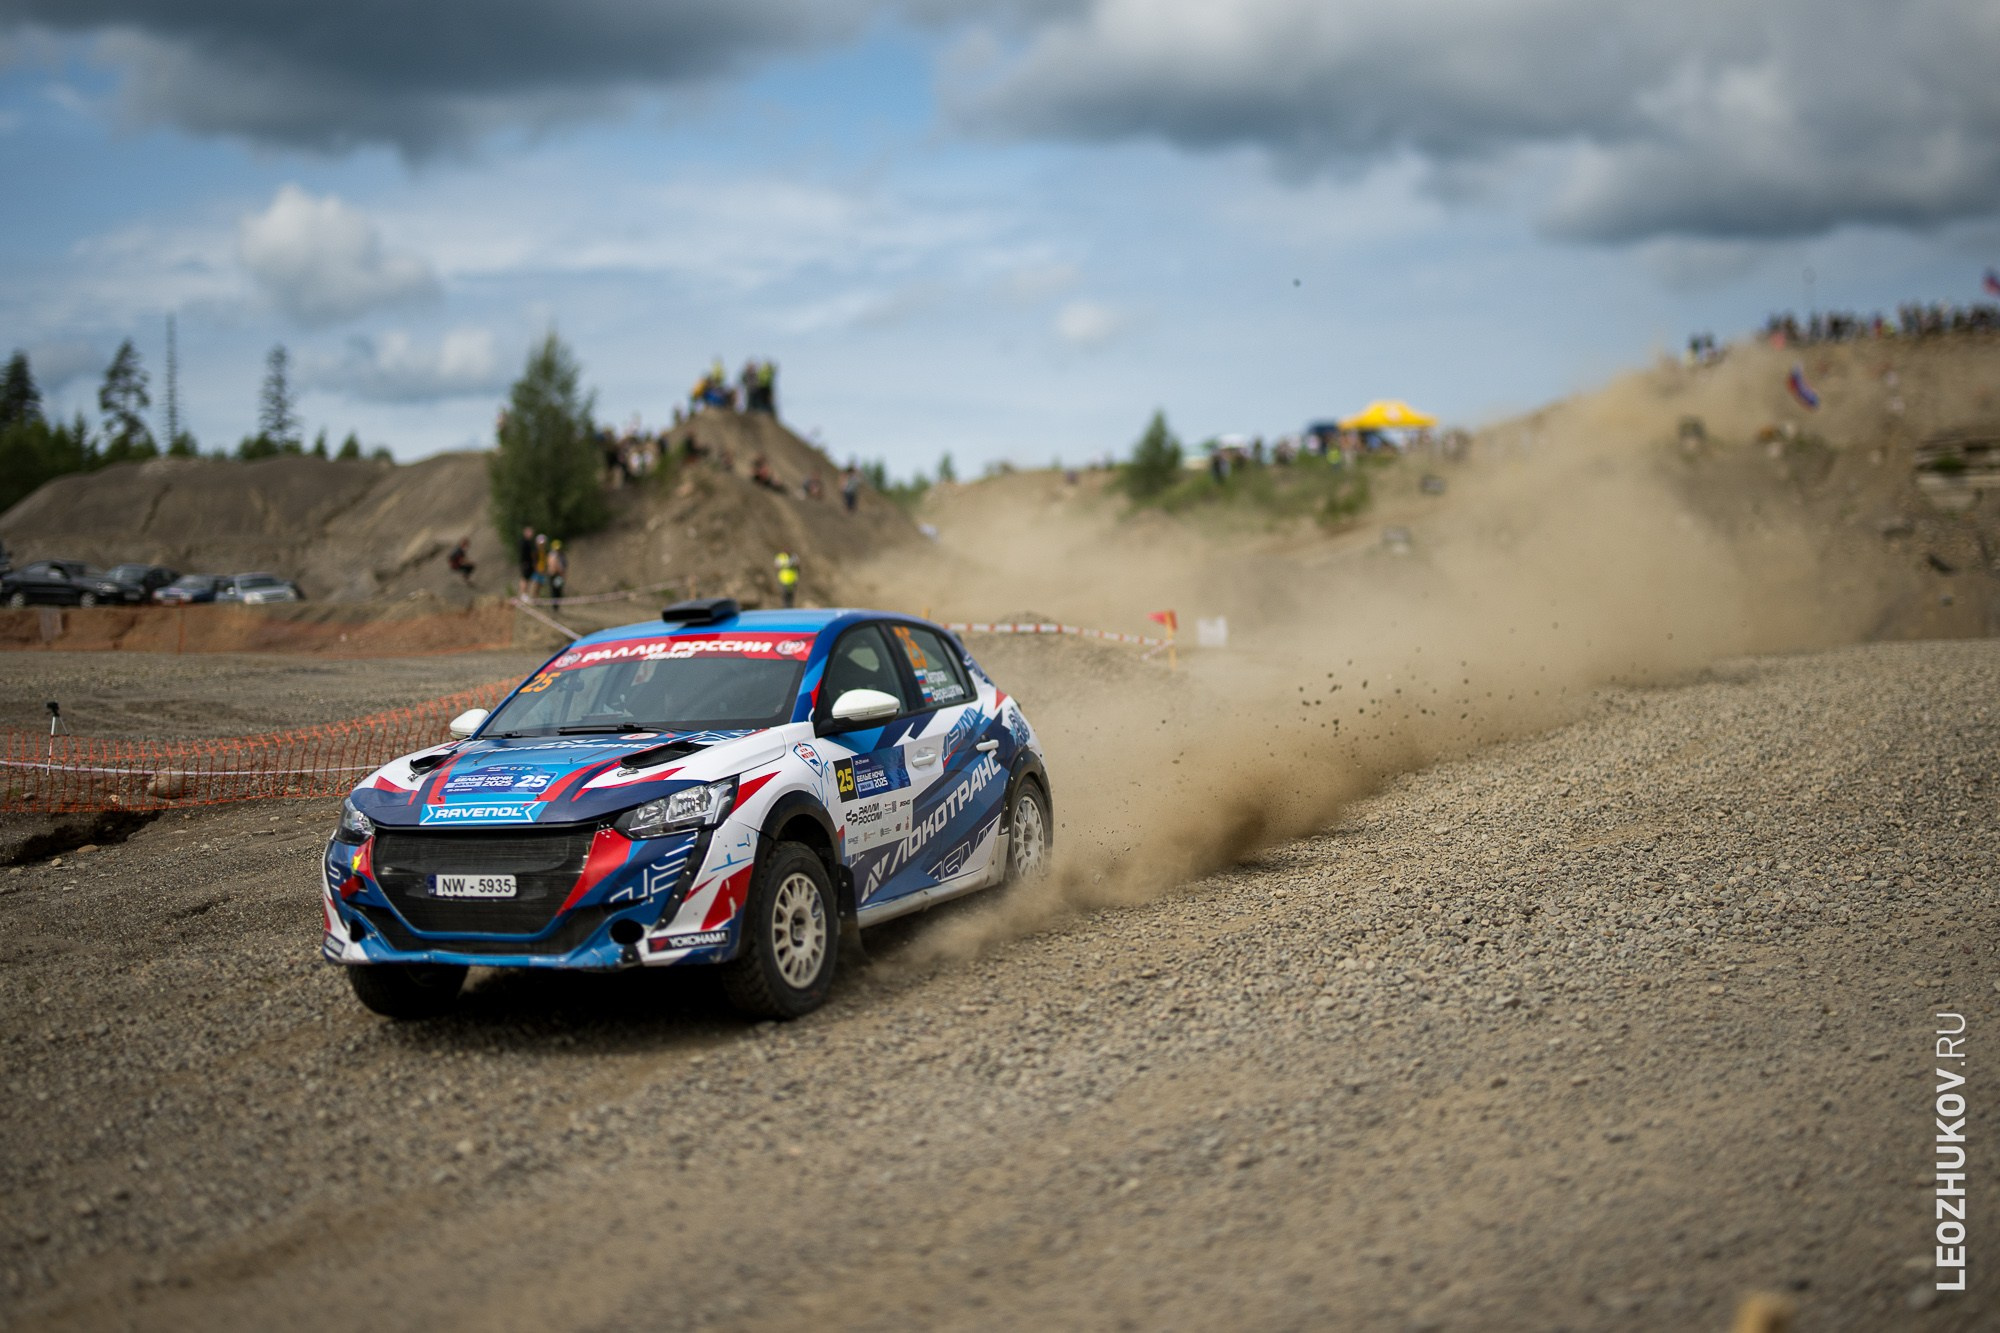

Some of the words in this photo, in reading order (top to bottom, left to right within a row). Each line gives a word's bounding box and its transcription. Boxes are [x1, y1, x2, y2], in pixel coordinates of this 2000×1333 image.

[581, 642, 667, 663] РАЛЛИ
[670, 640, 772, 654] РОССИИ
[893, 626, 928, 668] 25
[519, 672, 561, 693] 25
[514, 775, 551, 787] 25
[837, 768, 854, 792] 25
[856, 773, 872, 783] БЕЛЫЕ
[872, 770, 885, 779] НОЧИ
[874, 776, 889, 788] 2025
[434, 806, 524, 819] RAVENOL
[858, 802, 880, 815] РАЛЛИ
[889, 748, 1002, 875] ЛОКОТРАНС
[858, 811, 883, 825] РОССИИ
[442, 878, 466, 892] NW
[478, 878, 512, 893] 5935
